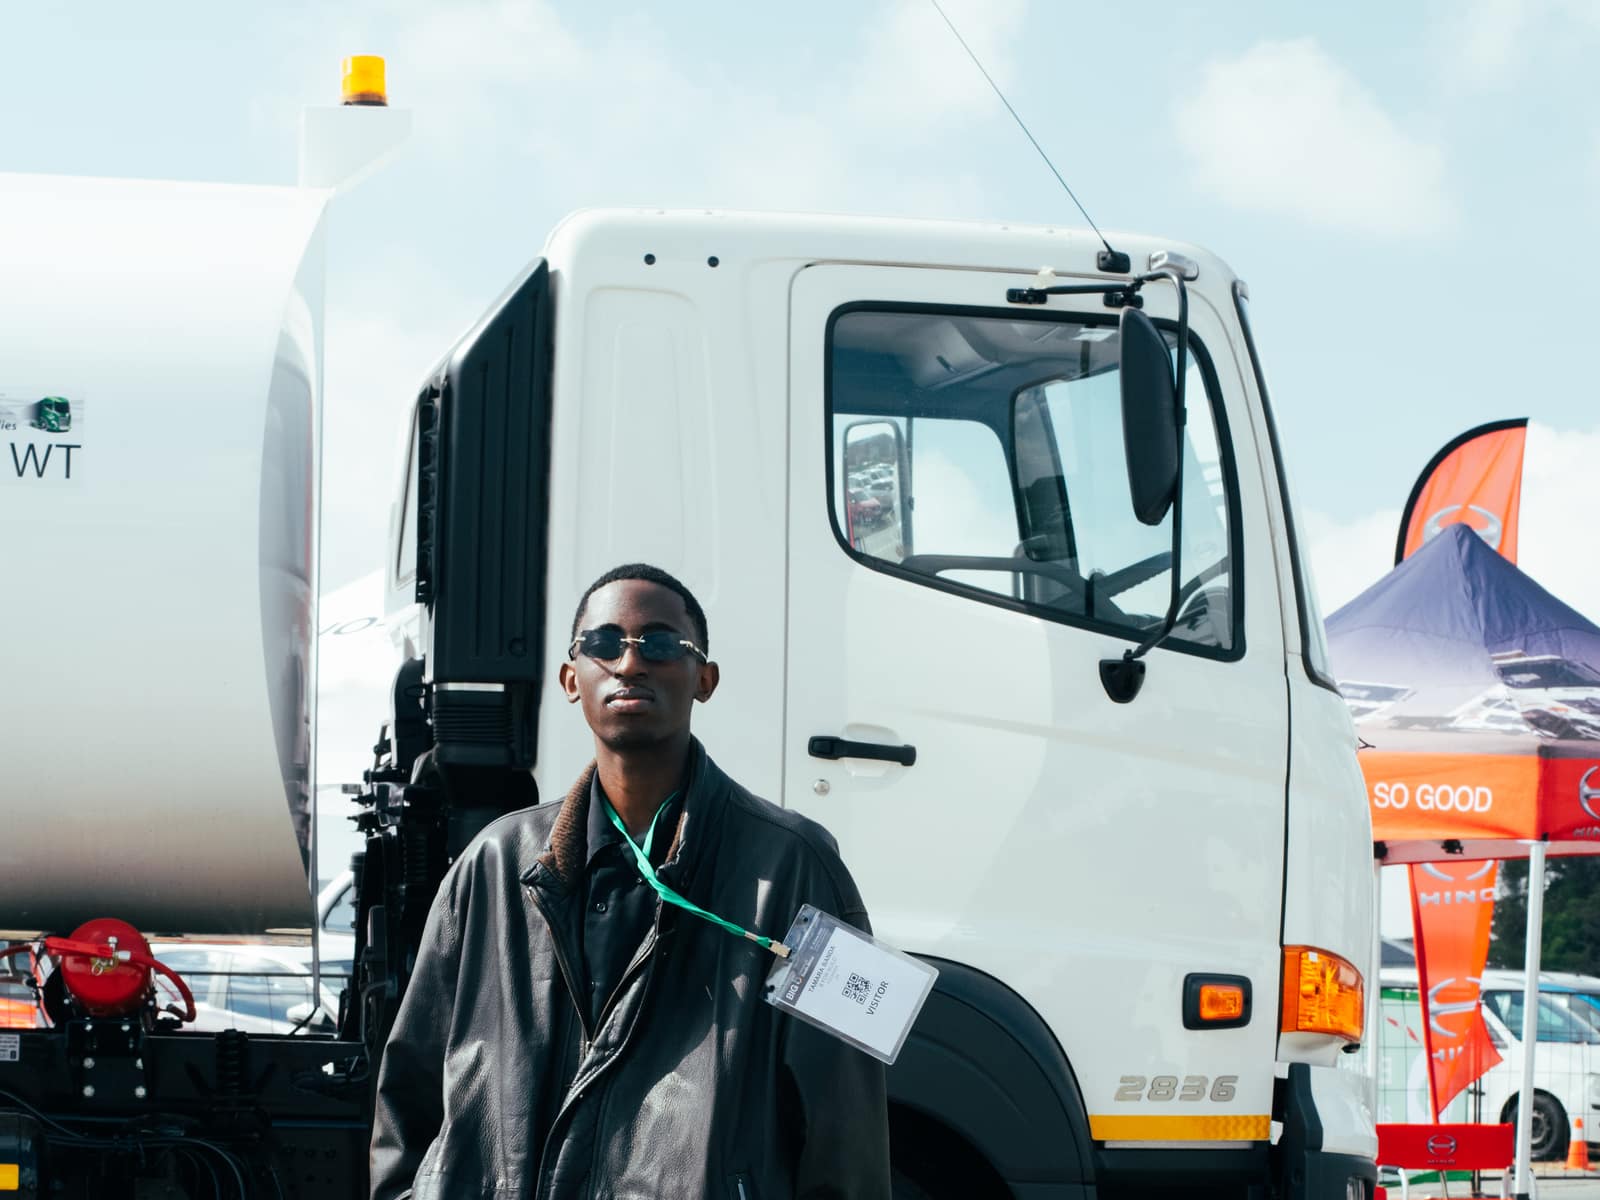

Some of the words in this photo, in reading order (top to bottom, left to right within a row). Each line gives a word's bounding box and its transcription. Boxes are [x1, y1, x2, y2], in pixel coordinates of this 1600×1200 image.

[10, 442, 82, 479] WT
[1373, 782, 1409, 809] SO
[1415, 783, 1493, 813] GOOD
[785, 984, 799, 1000] BIG
[866, 981, 889, 1015] VISITOR
[1114, 1075, 1239, 1102] 2836
